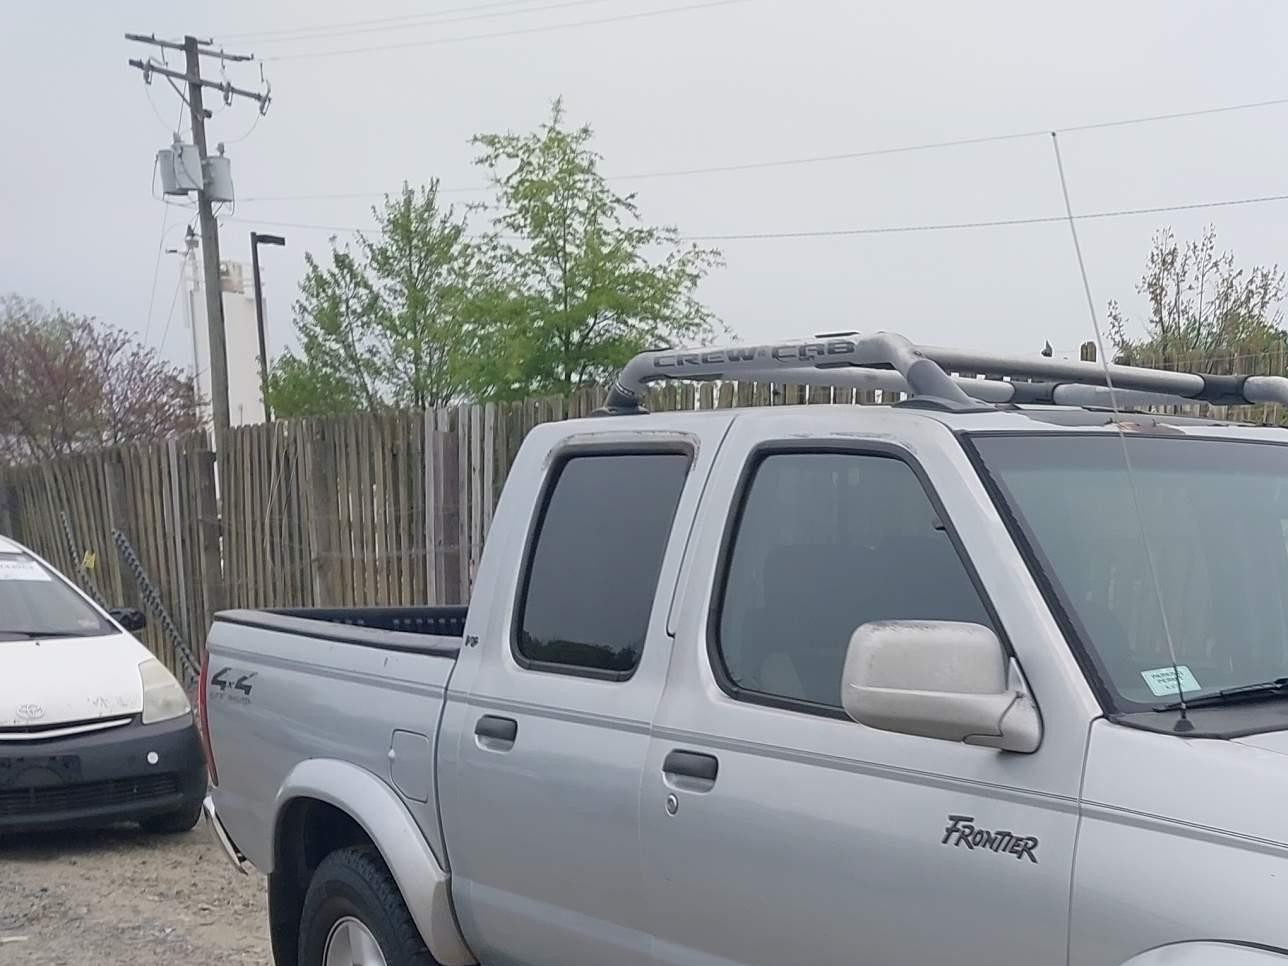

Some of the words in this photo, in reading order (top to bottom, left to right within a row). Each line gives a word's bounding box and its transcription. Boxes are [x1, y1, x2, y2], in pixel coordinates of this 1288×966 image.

[653, 346, 756, 368] CREW
[771, 339, 856, 362] CAB
[941, 814, 1039, 864] FRONTIER
